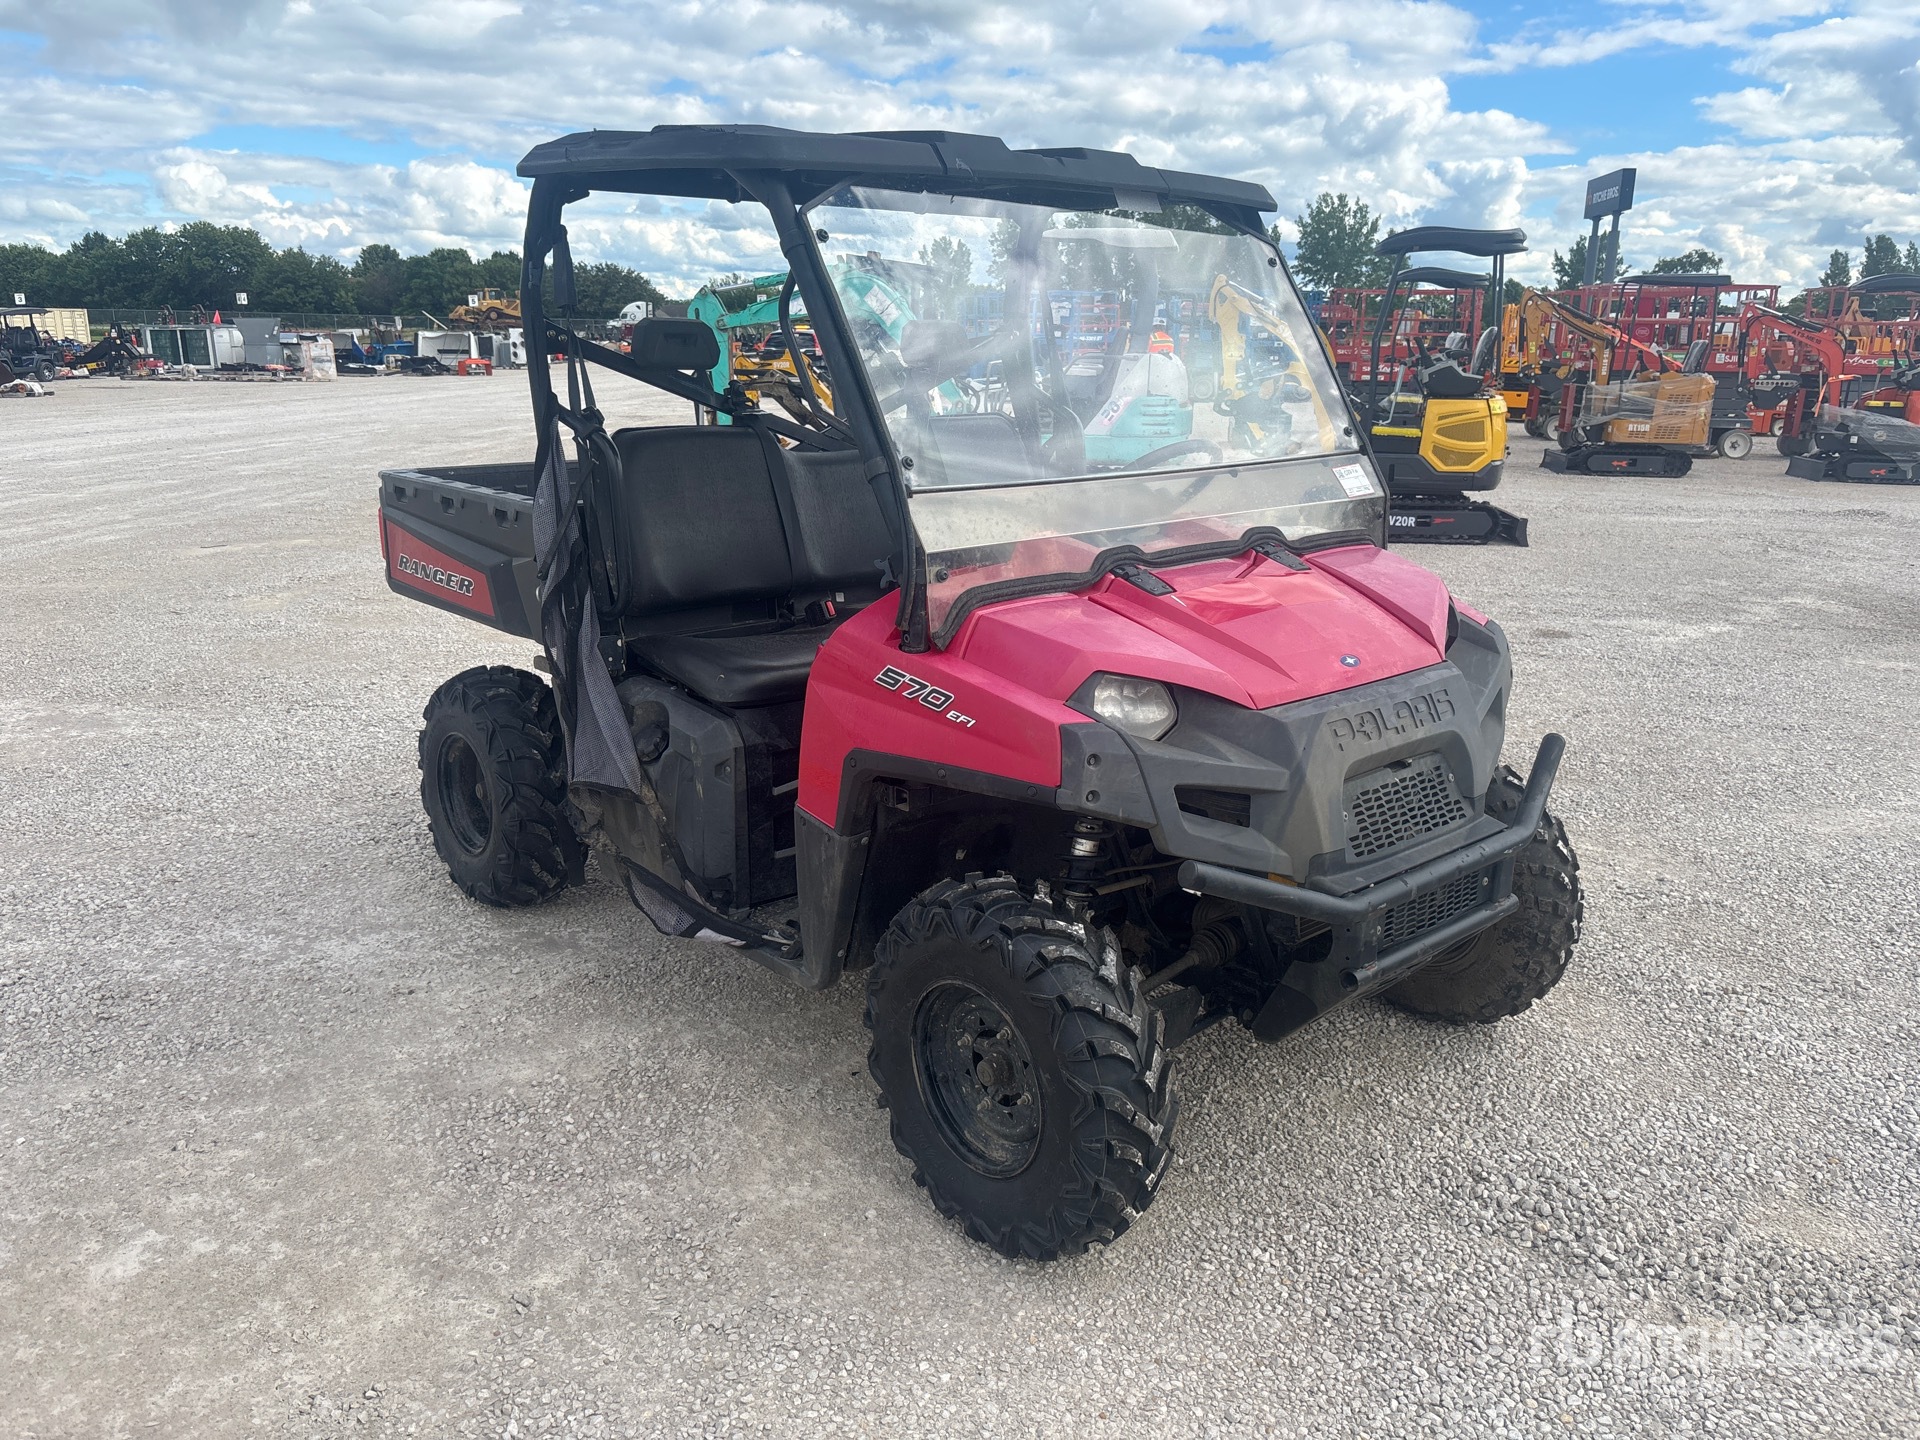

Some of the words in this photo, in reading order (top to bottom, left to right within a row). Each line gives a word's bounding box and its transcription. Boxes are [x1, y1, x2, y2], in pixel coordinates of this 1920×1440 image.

[1843, 356, 1879, 366] YJACK
[397, 553, 475, 597] RANGER
[873, 664, 955, 712] 570
[945, 710, 976, 728] EFI
[1326, 688, 1456, 752] POLARIS
